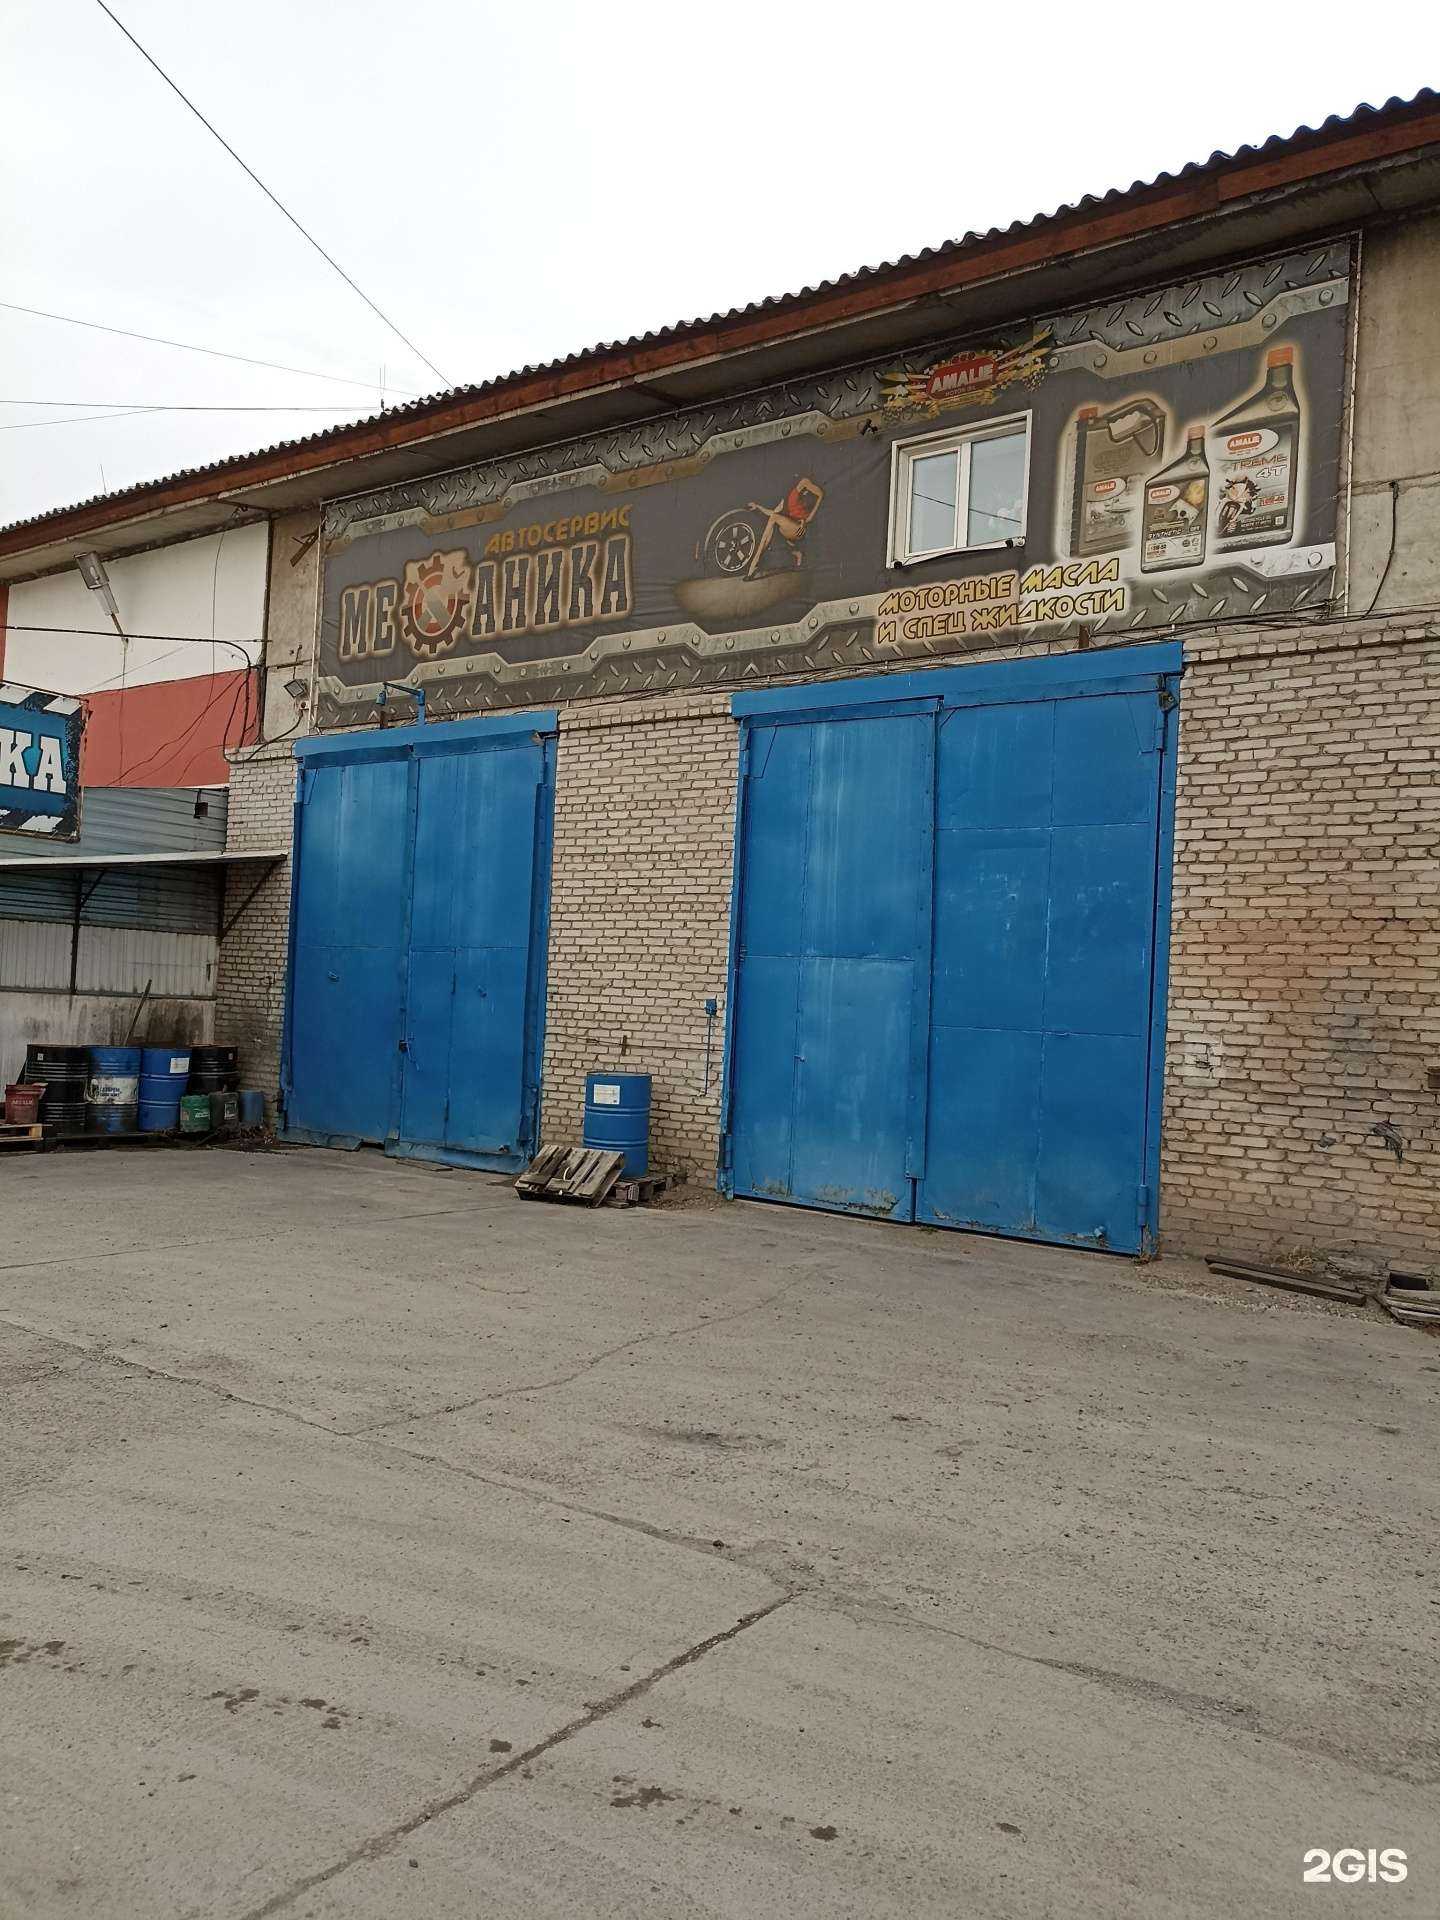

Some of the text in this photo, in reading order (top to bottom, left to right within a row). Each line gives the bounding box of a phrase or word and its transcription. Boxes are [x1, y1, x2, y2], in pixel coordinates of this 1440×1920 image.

[931, 363, 994, 393] AMALIE
[1228, 435, 1260, 449] AMALIE
[1256, 464, 1288, 479] 4T
[484, 503, 634, 555] АВТОСЕРВИС
[878, 558, 1120, 616] МОТОРНЫЕ МАСЛА
[877, 587, 1126, 644] И СПЕЦ ЖИДКОСТИ
